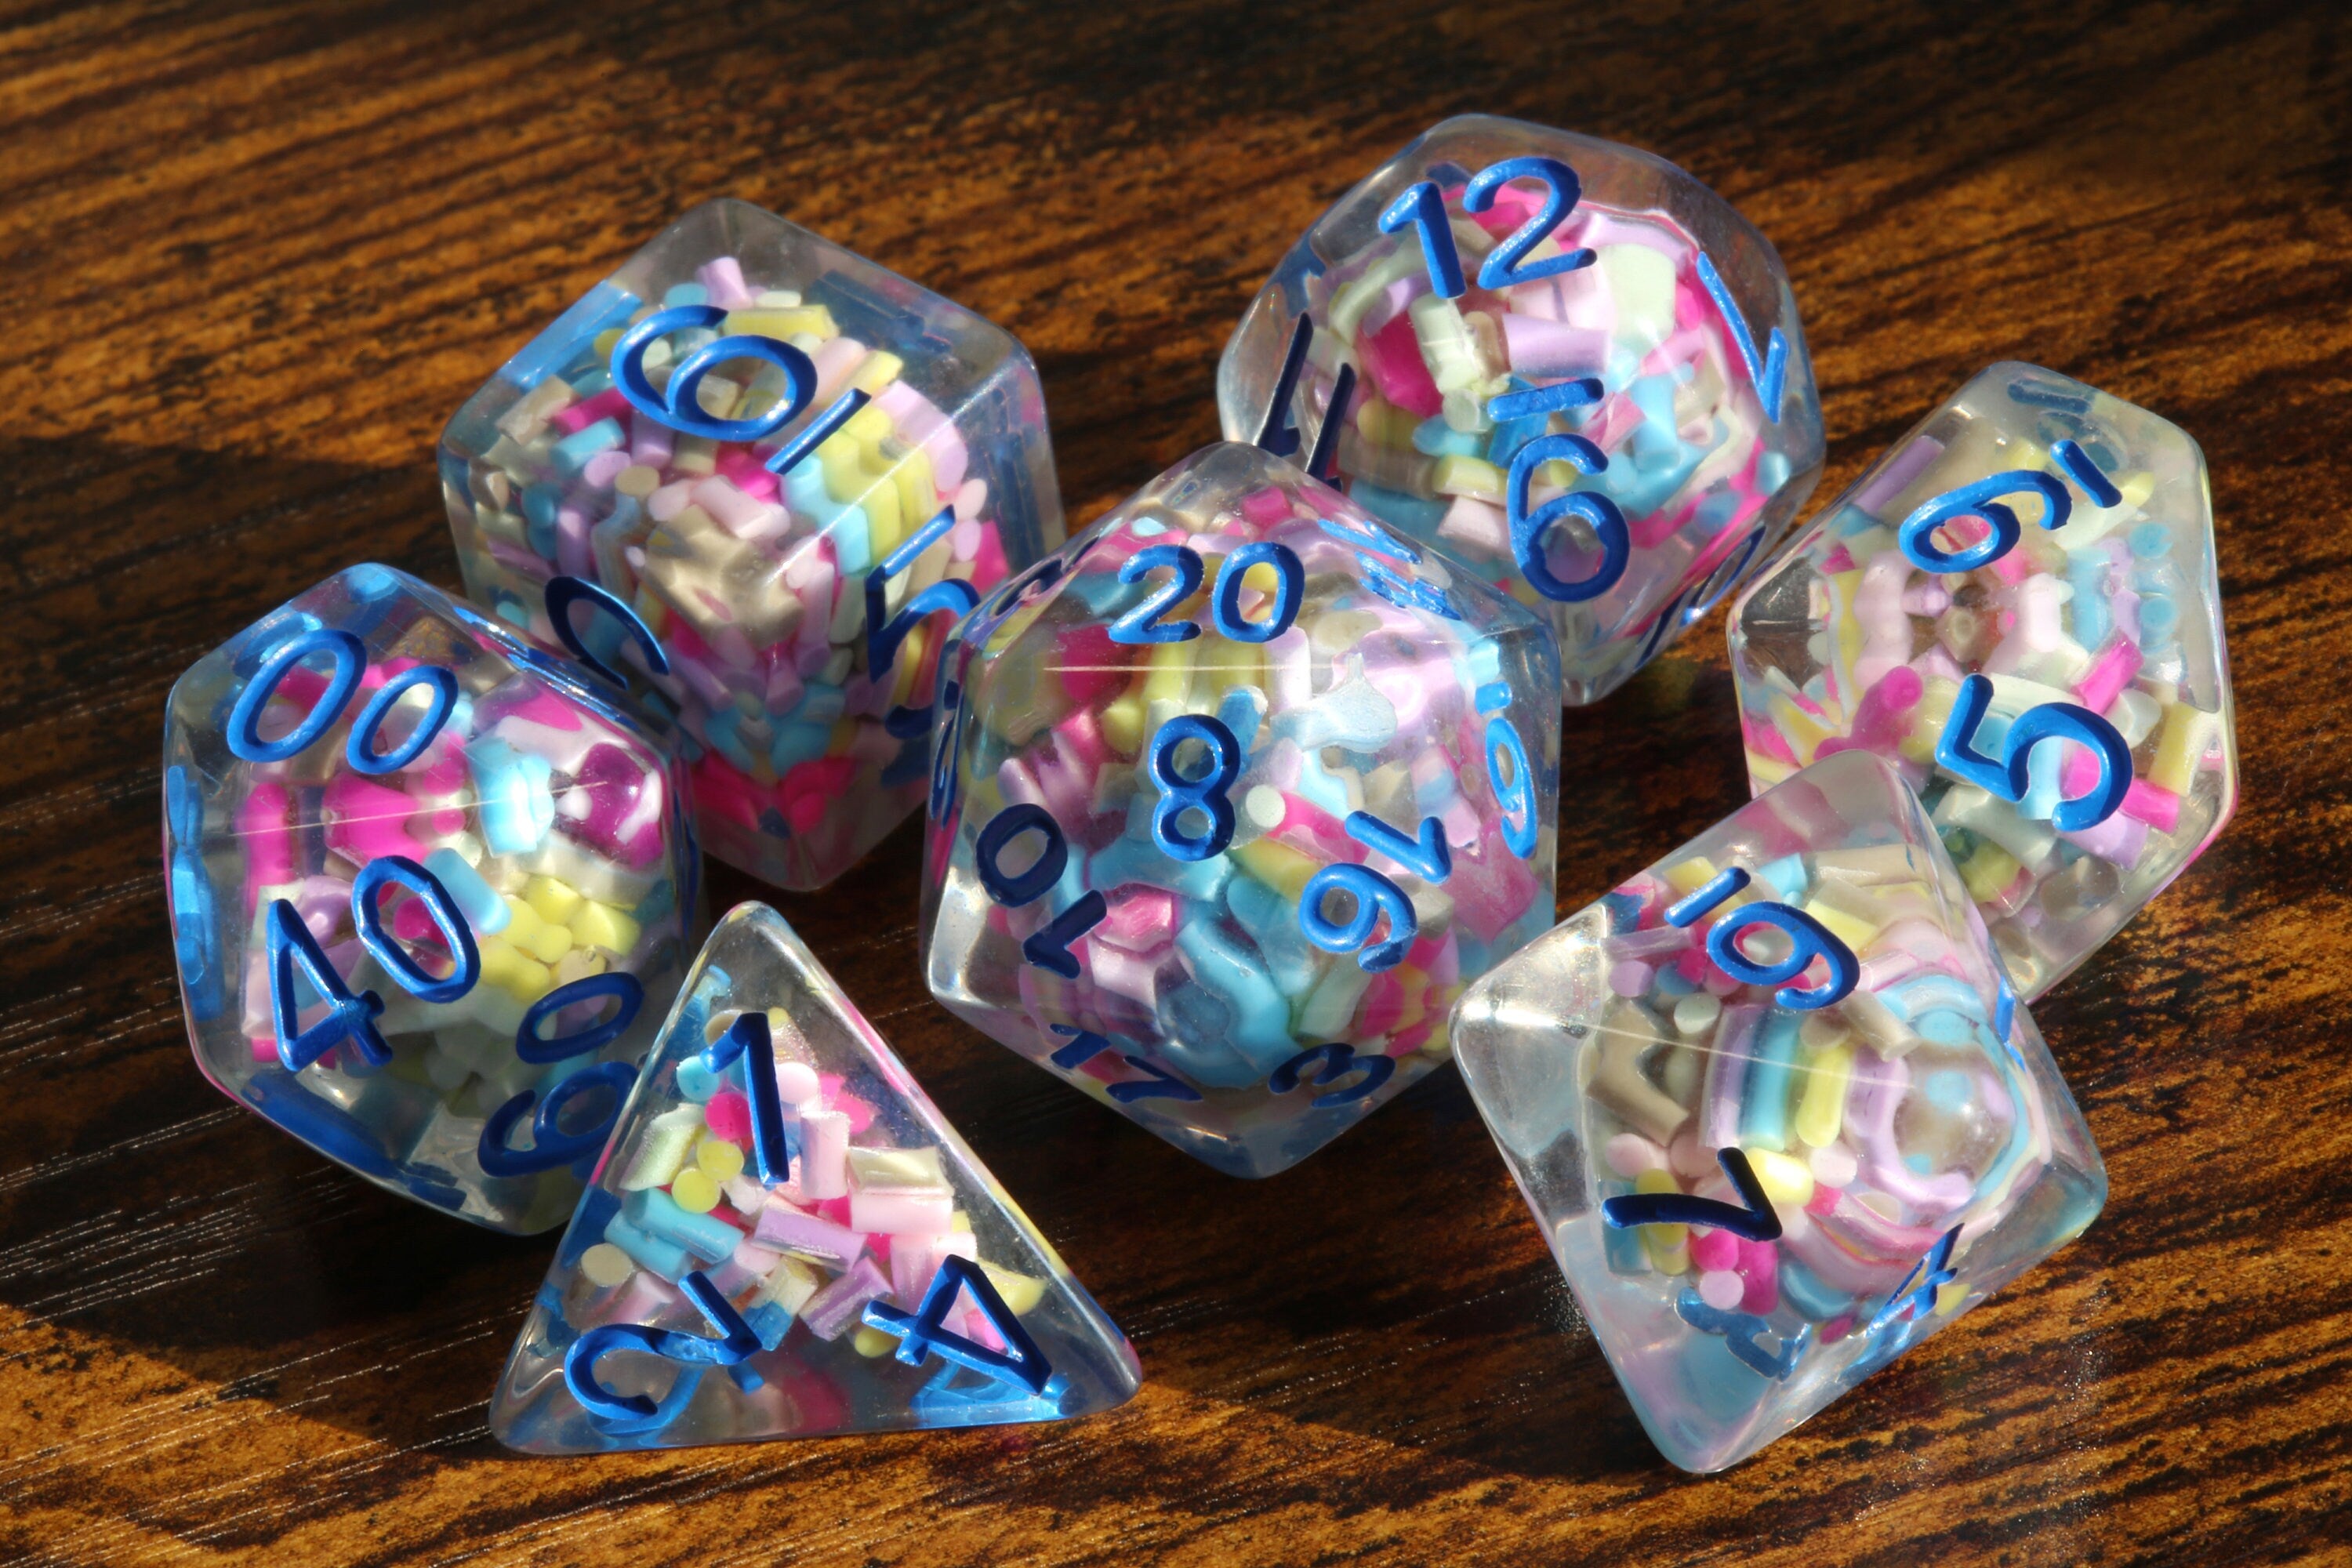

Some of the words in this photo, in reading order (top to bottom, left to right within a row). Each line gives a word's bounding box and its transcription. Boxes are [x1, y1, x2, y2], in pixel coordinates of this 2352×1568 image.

[1379, 157, 1598, 298] 12
[611, 305, 817, 441] 6
[1109, 541, 1305, 644] 20
[227, 630, 459, 775] 00
[1935, 673, 2133, 833] 5
[1149, 713, 1241, 862] 8
[267, 855, 481, 1072] 40
[976, 803, 1107, 980] 10
[699, 1011, 790, 1189] 1
[1269, 1042, 1396, 1108] 3
[1602, 1147, 1784, 1242] 7
[564, 1270, 764, 1416] 2
[862, 1254, 1053, 1395] 4
